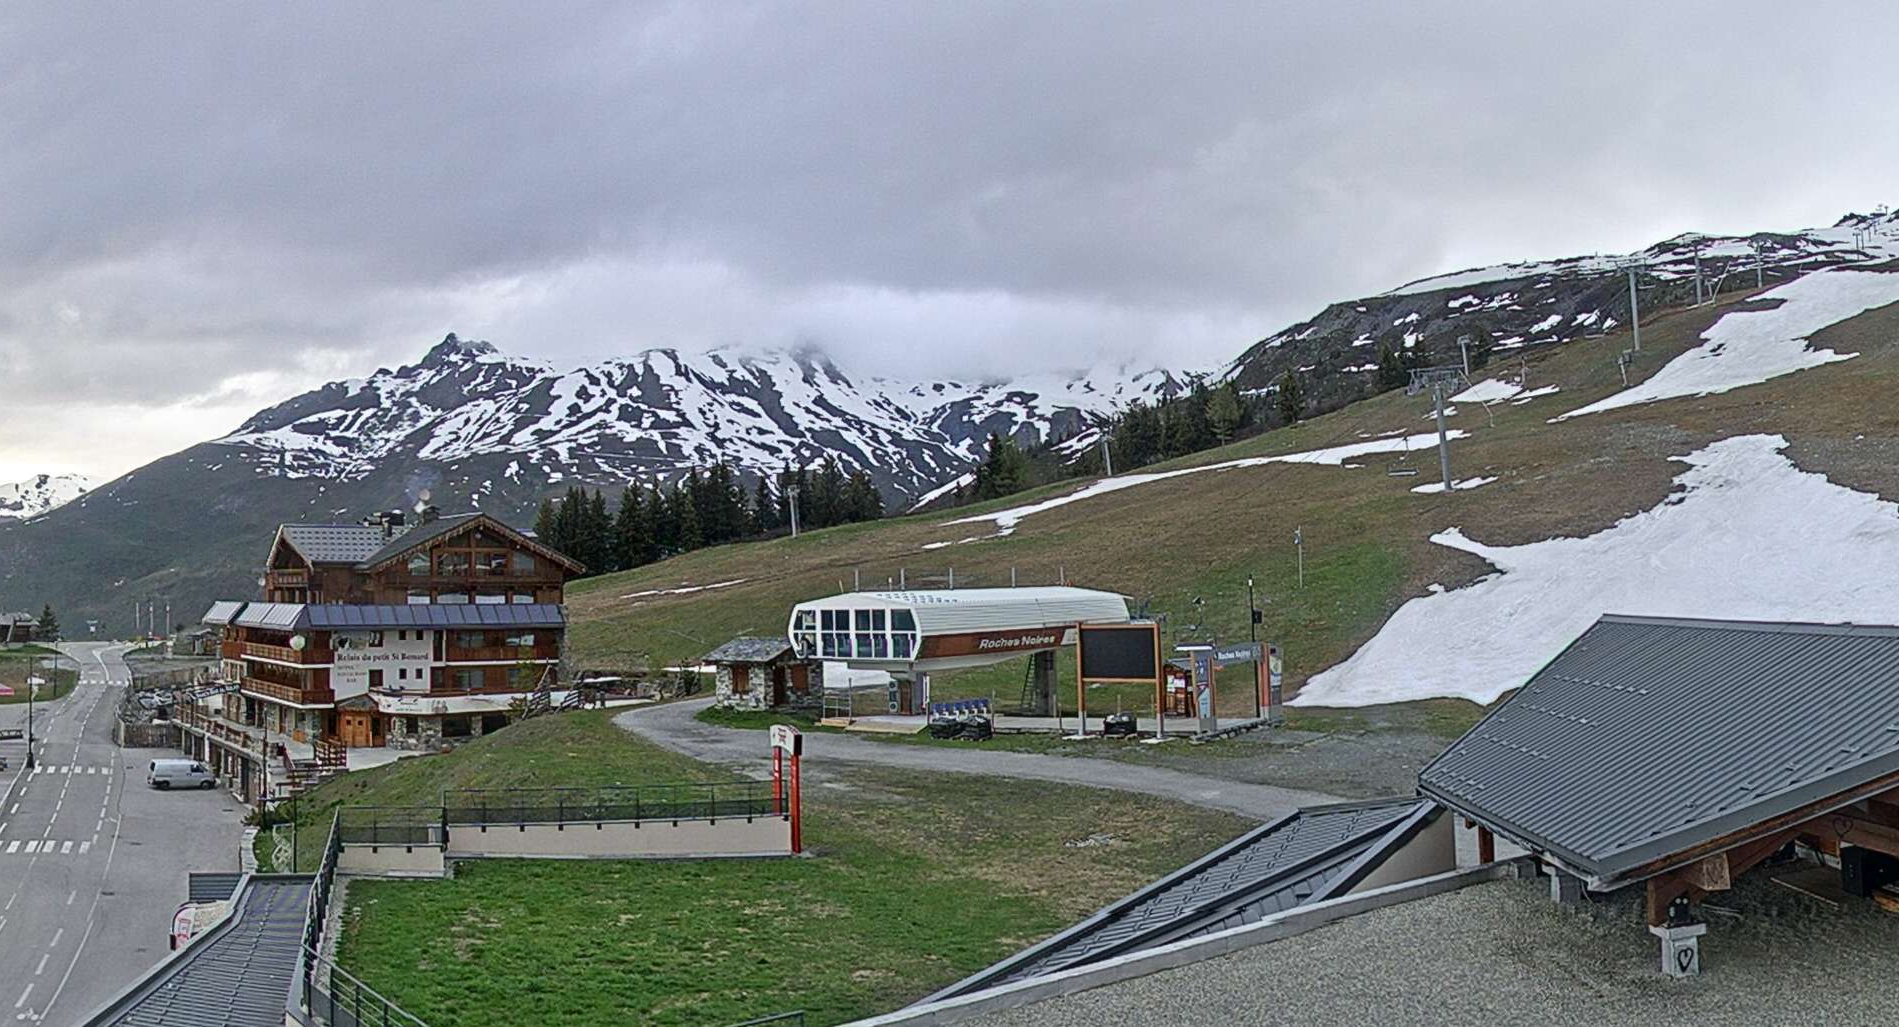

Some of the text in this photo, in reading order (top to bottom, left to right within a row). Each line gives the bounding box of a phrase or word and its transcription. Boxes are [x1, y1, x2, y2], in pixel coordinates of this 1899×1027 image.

[979, 635, 1056, 649] Roches Noires
[337, 653, 360, 661] Relais
[373, 652, 390, 662] petit
